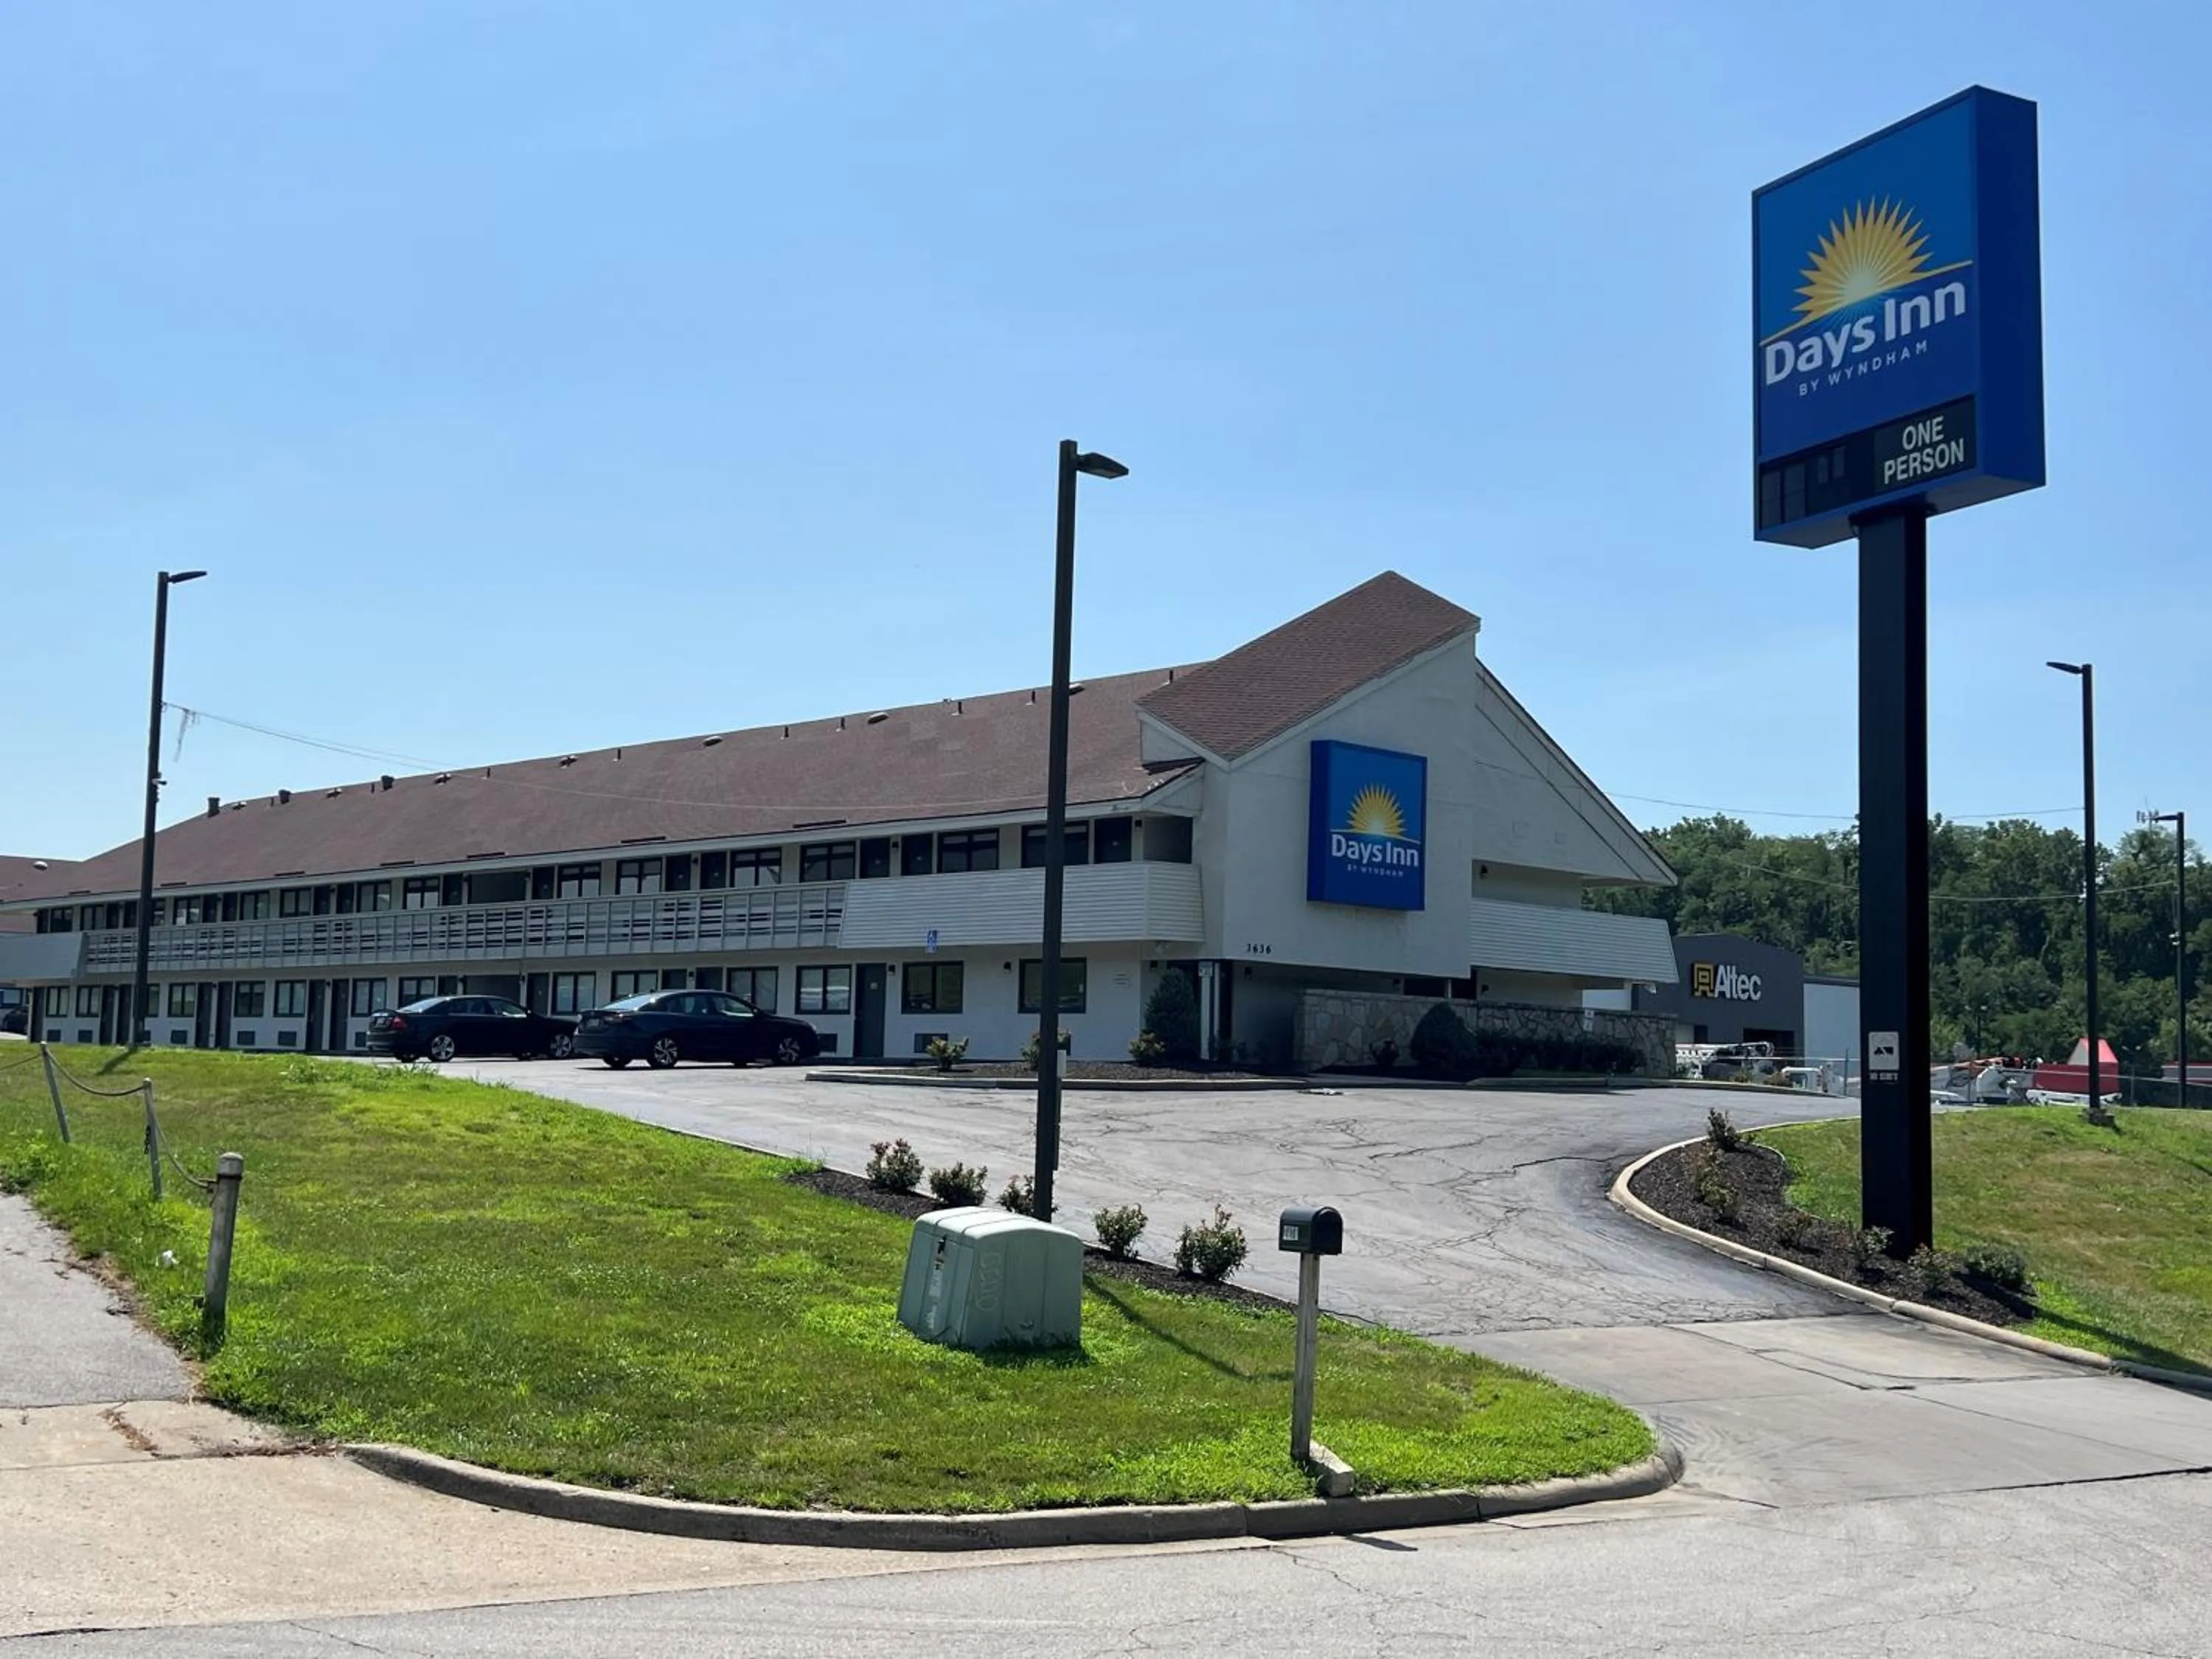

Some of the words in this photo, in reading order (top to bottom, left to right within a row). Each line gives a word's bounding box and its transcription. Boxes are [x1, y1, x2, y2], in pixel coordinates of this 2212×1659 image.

[1765, 316, 1876, 385] Days
[1884, 282, 1966, 342] Inn
[1798, 379, 1819, 396] BY
[1828, 340, 1927, 386] WYNDHAM
[1902, 416, 1944, 451] ONE
[1884, 438, 1964, 484] PERSON
[1331, 834, 1382, 865] Days
[1385, 842, 1419, 867] Inn
[1346, 863, 1357, 872] BY
[1360, 866, 1404, 877] WYNDHAM
[1714, 964, 1761, 1001] Altec
